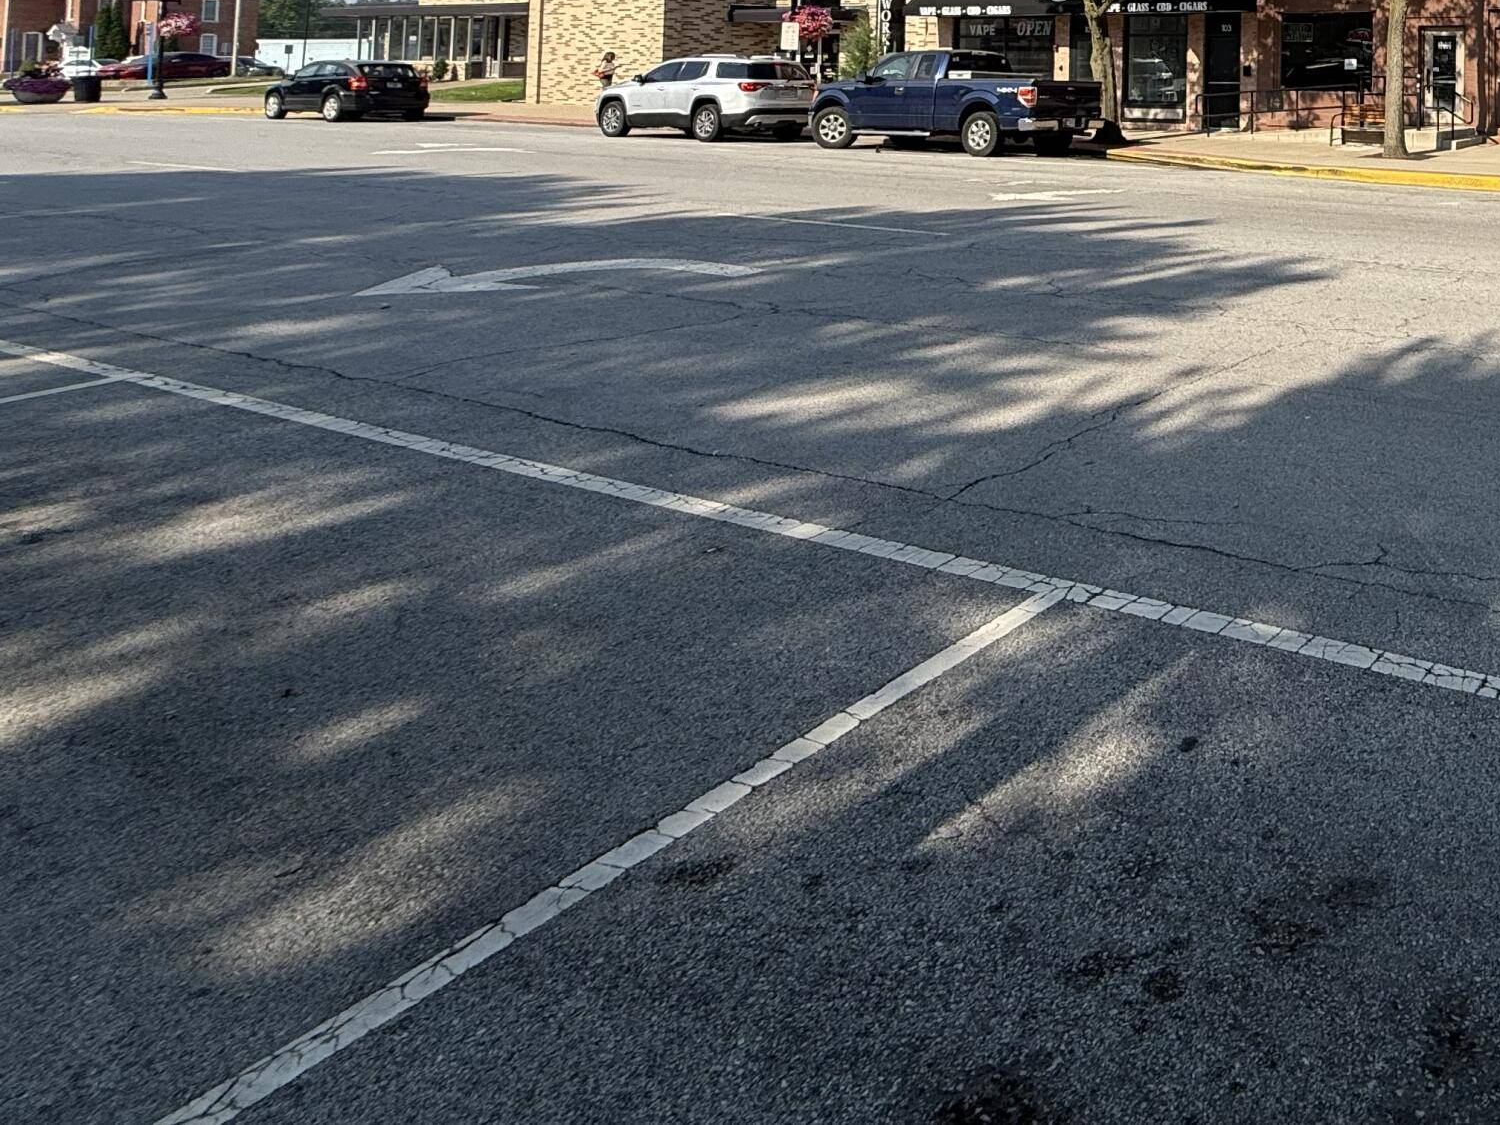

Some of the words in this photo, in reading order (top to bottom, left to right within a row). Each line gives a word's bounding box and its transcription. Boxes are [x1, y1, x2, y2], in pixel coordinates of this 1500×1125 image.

[919, 6, 937, 16] VAPE
[1127, 2, 1150, 13] GLASS
[1179, 1, 1208, 11] CIGARS
[969, 24, 996, 36] VAPE
[1016, 20, 1053, 36] OPEN
[1221, 24, 1232, 32] 103
